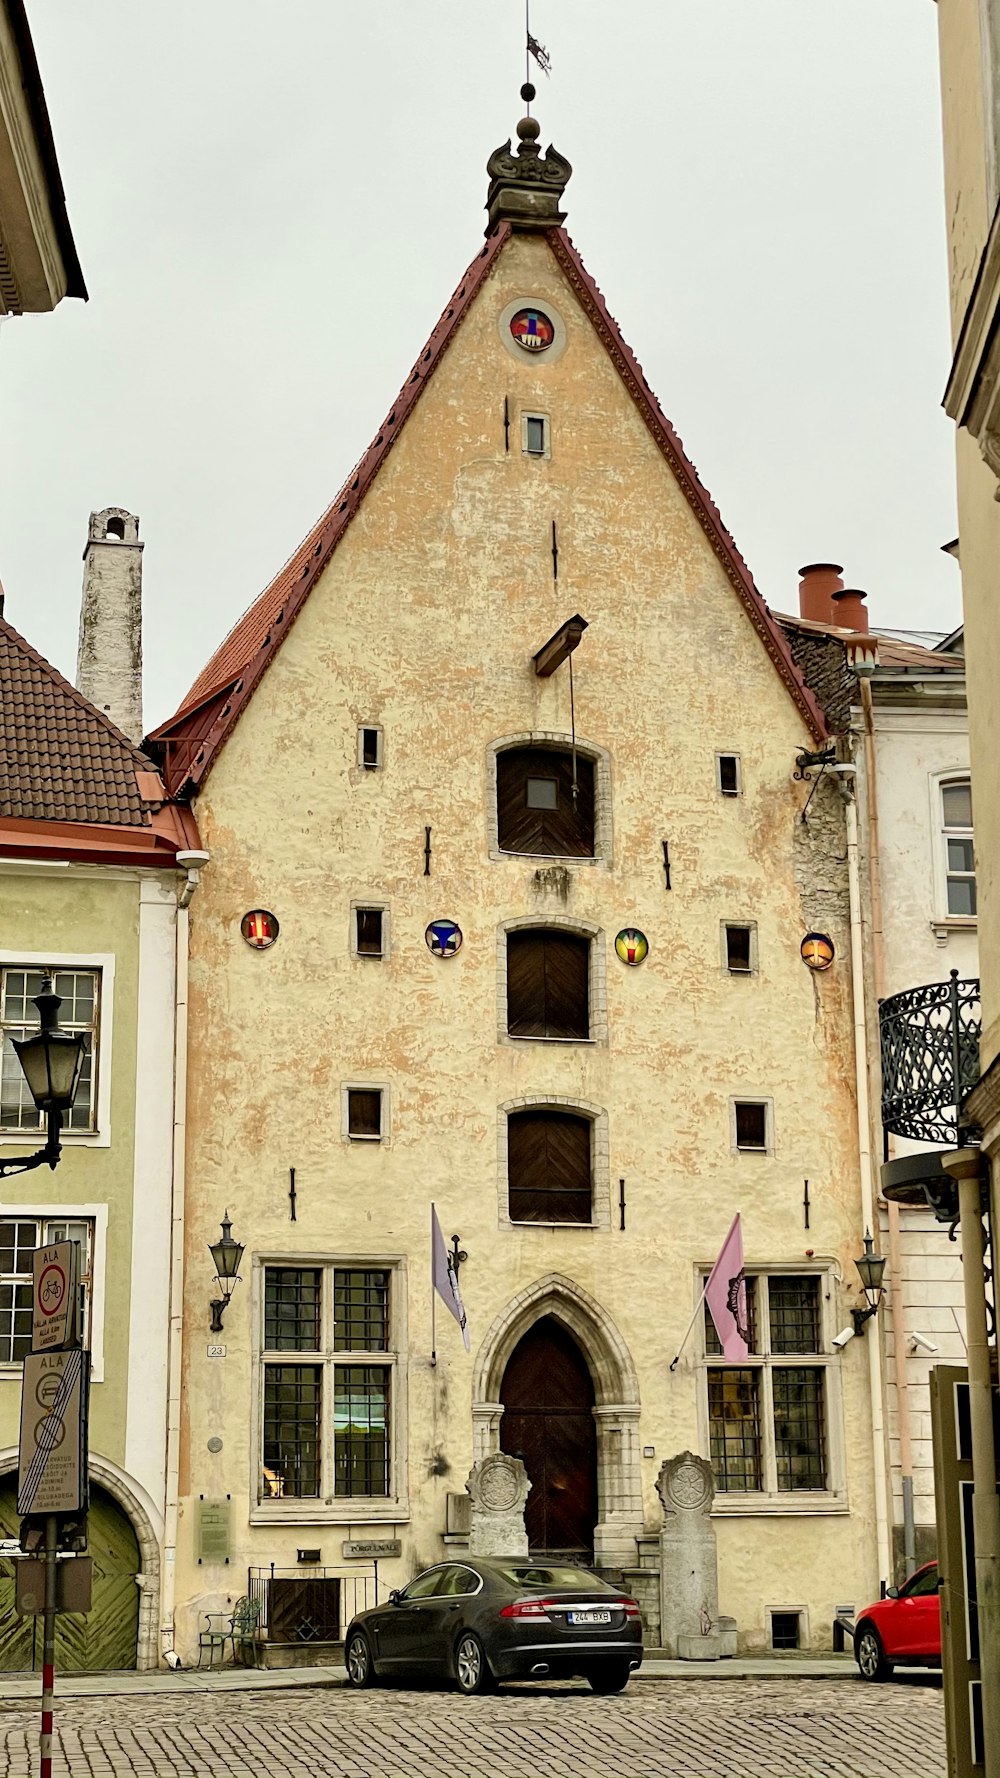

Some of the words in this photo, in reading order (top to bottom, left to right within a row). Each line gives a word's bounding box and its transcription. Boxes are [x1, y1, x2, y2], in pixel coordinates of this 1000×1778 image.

[43, 1250, 59, 1264] ALA
[211, 1346, 222, 1355] 23
[40, 1355, 64, 1369] ALA
[575, 1612, 589, 1621] 244
[593, 1612, 609, 1621] BXB
